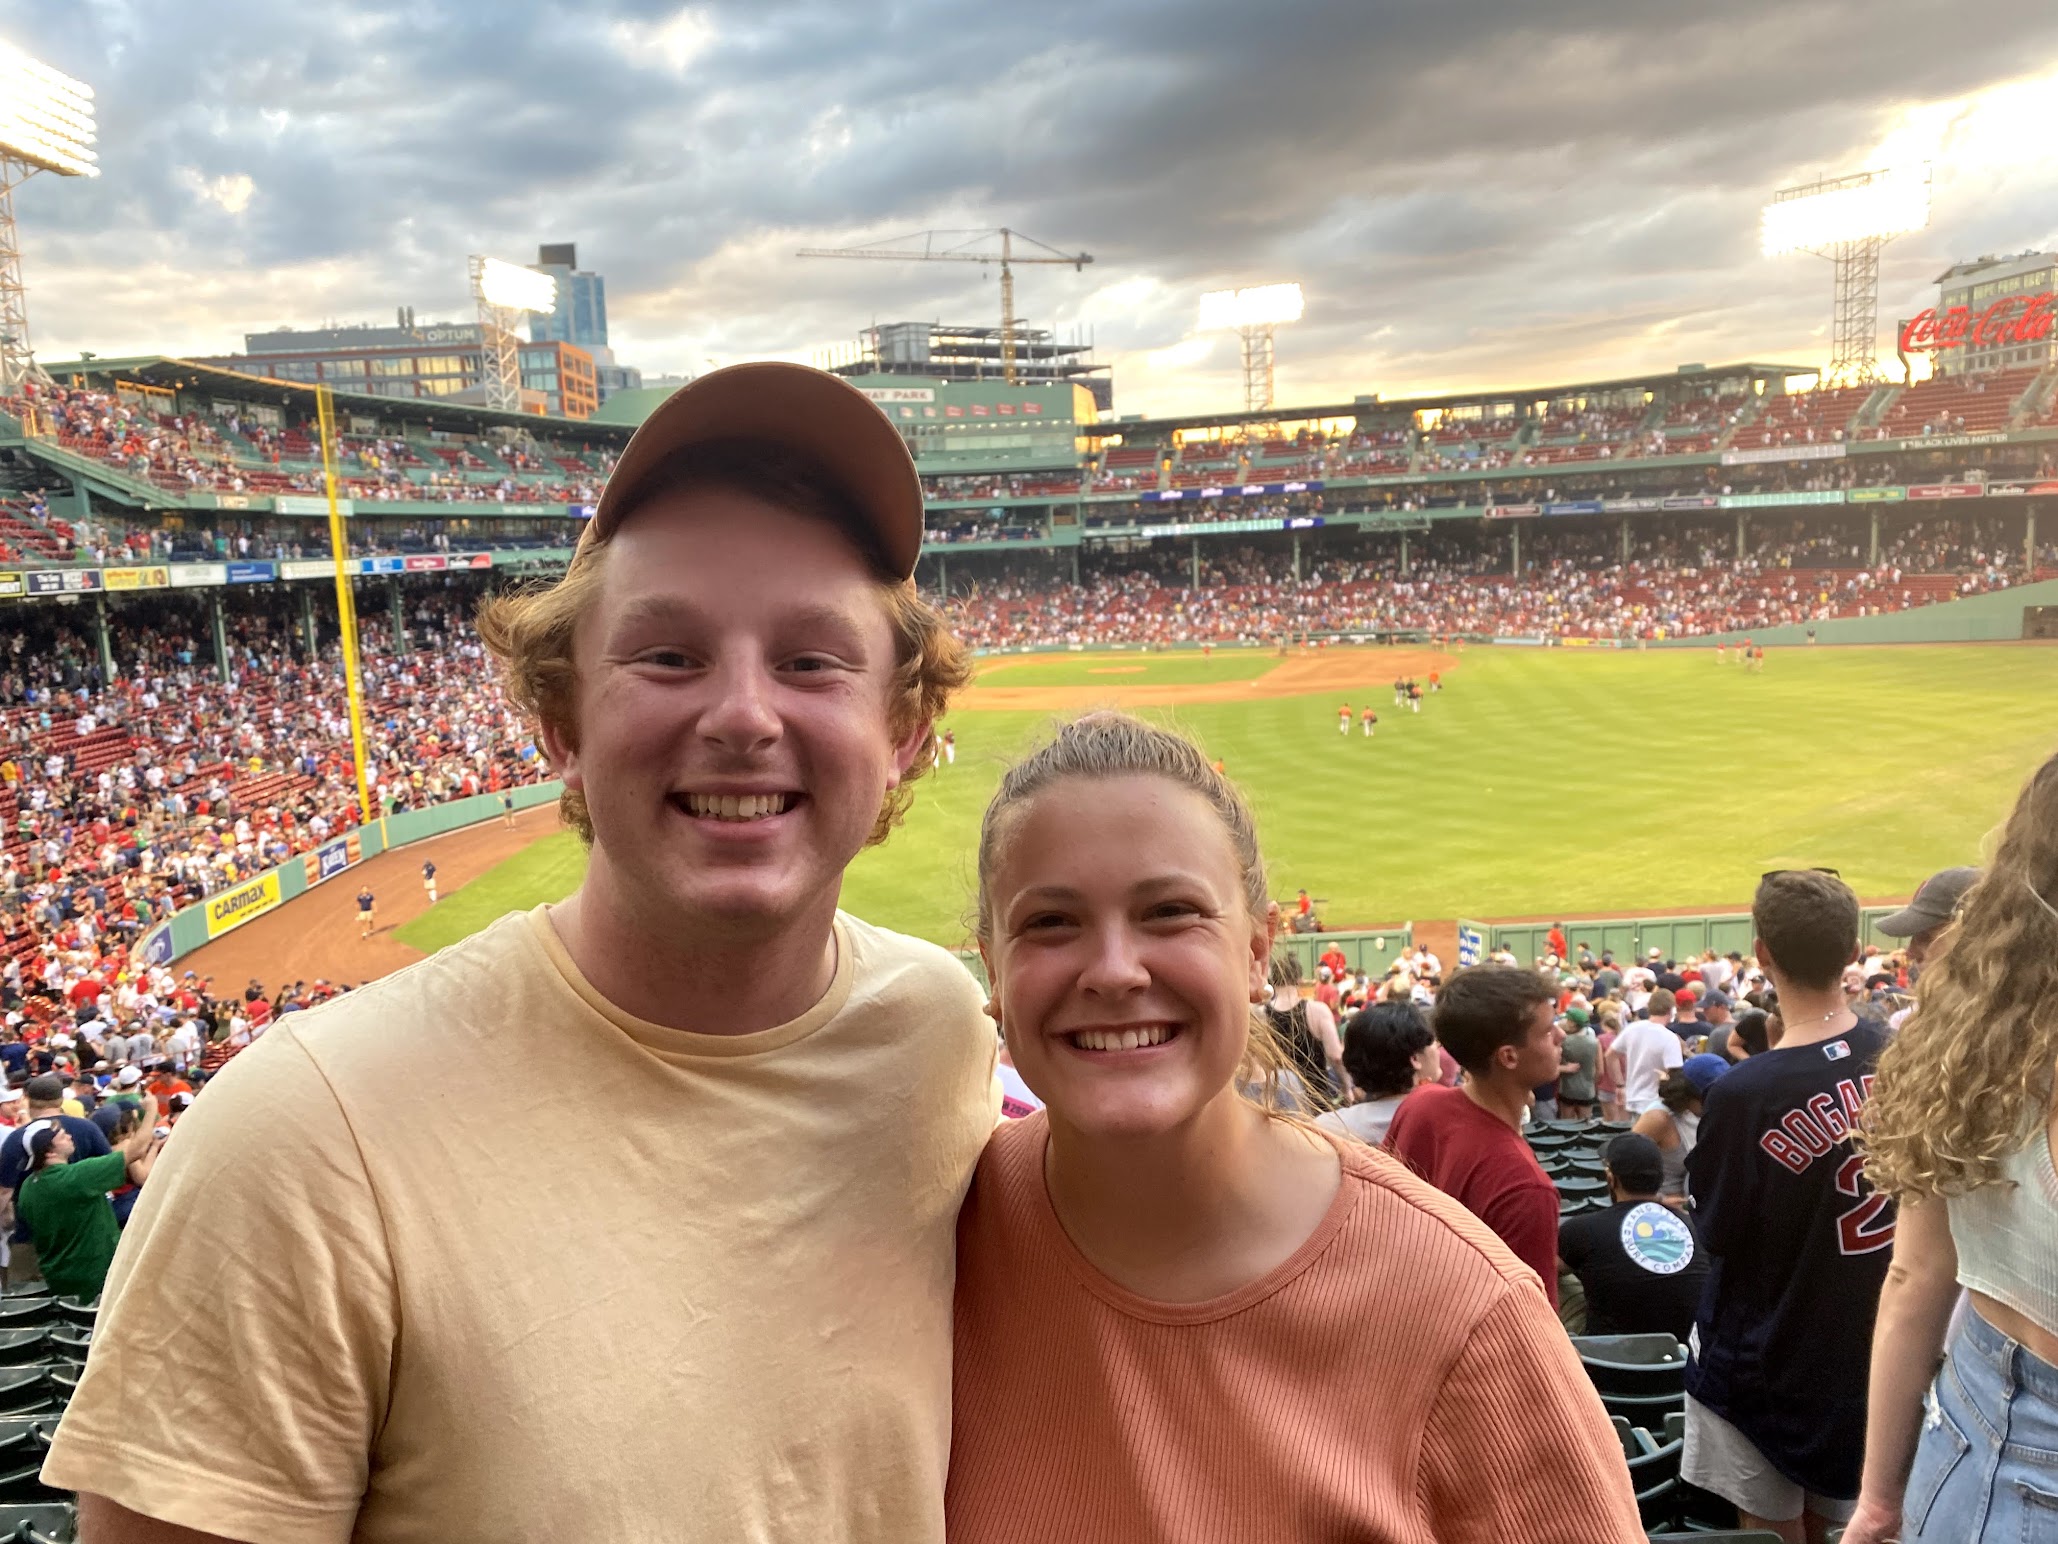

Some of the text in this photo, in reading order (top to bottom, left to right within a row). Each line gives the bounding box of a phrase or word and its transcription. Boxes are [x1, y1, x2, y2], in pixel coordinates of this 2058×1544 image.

[427, 328, 475, 341] OPTUM
[1901, 291, 2058, 353] Coca-Cola
[894, 391, 927, 399] PARK
[1914, 433, 2008, 449] BLACK LIVES MATTER
[1760, 1074, 1876, 1175] BOGA
[1626, 1204, 1652, 1228] HANG
[1835, 1152, 1896, 1256] 2
[1624, 1237, 1649, 1263] SURF
